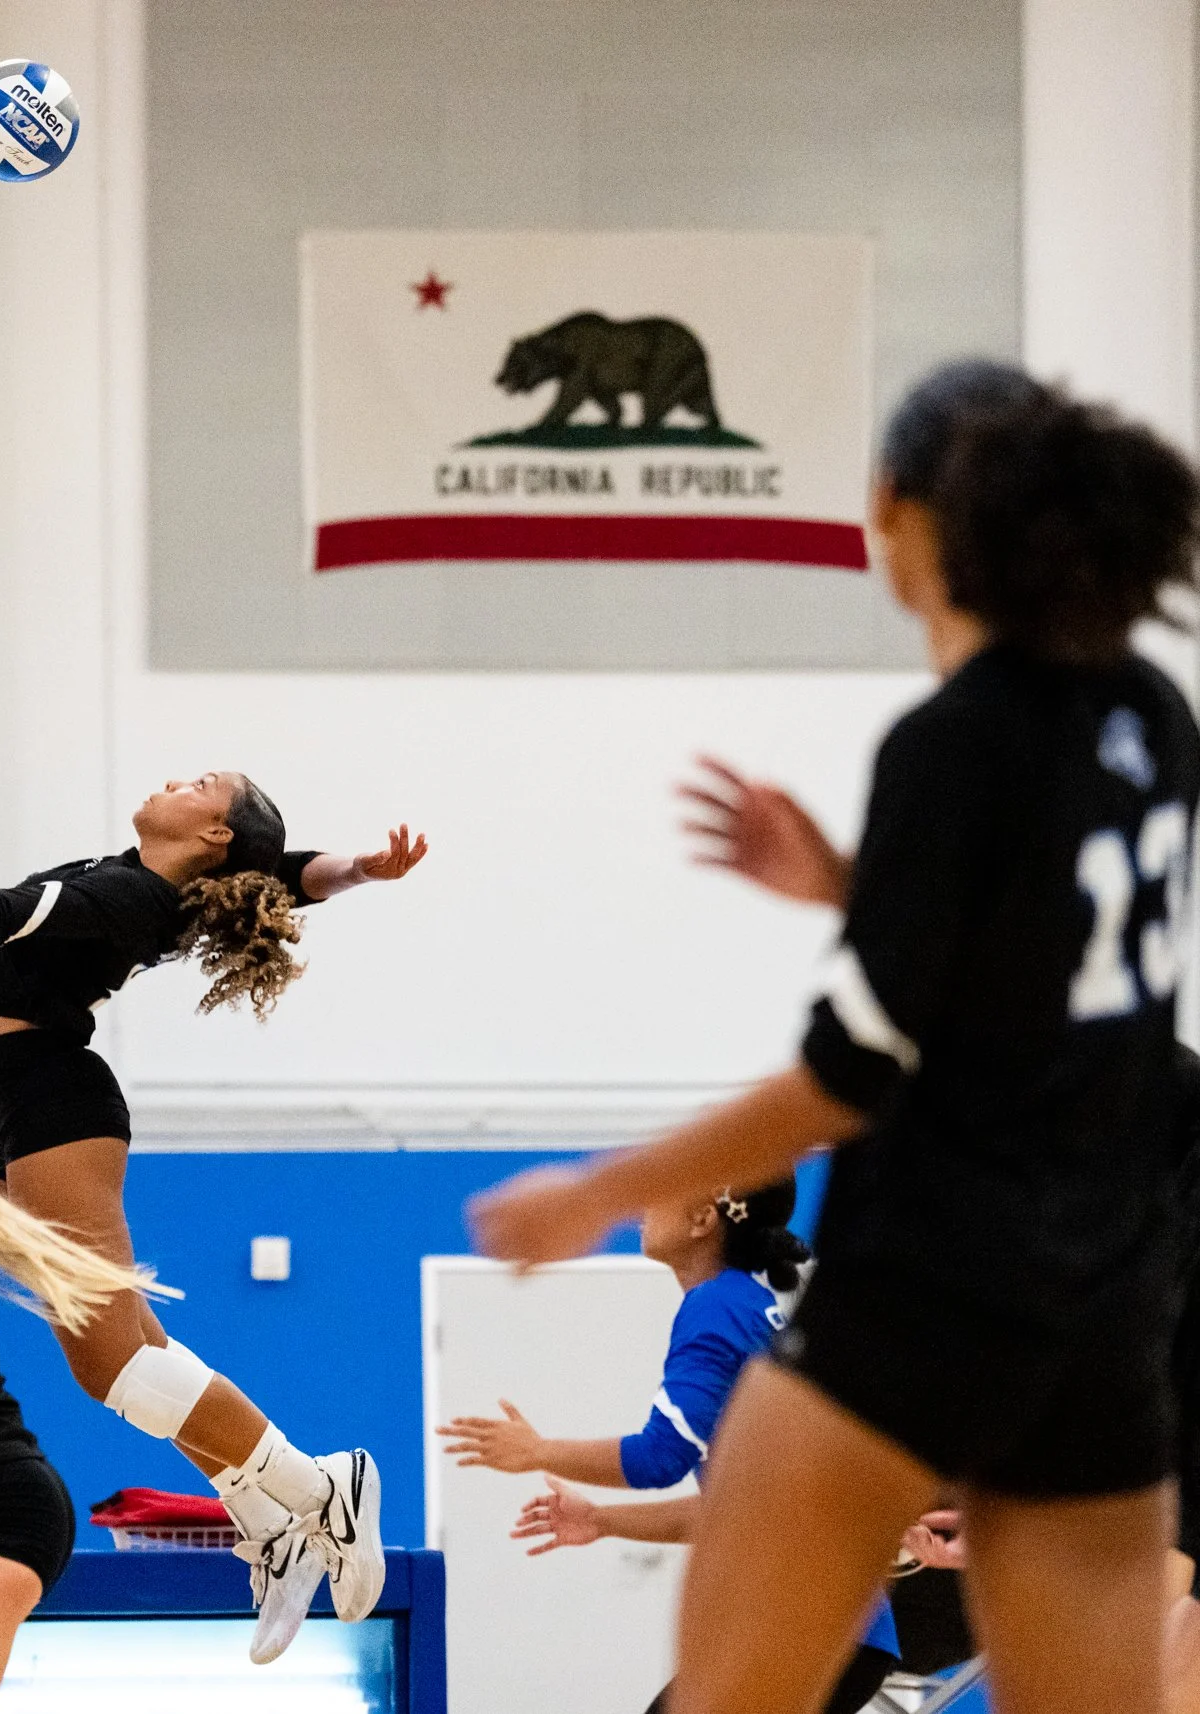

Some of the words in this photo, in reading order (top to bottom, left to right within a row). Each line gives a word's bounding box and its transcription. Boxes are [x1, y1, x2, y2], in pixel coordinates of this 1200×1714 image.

[11, 84, 64, 137] molten
[435, 463, 615, 496] CALIFORNIA
[640, 463, 781, 497] REPUBLIC
